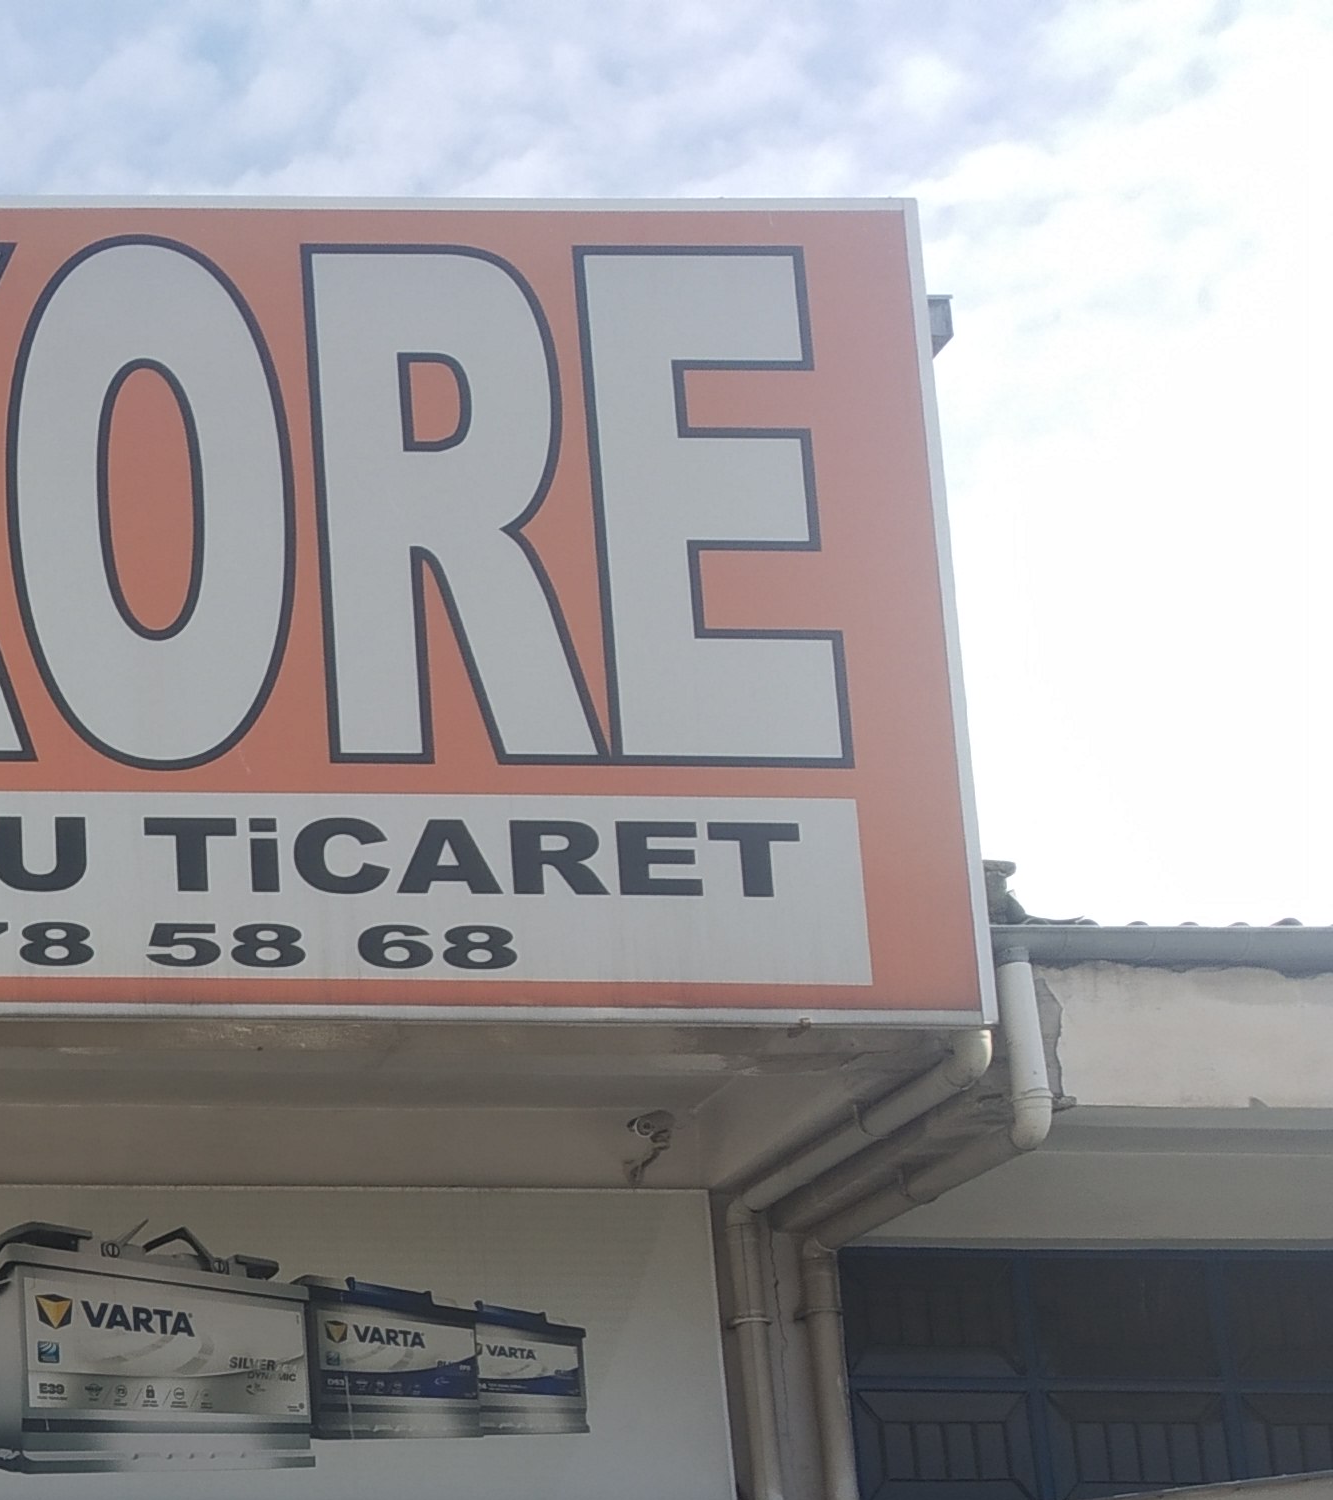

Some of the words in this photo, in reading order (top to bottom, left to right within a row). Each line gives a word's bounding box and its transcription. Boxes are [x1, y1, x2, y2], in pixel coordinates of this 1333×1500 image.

[145, 921, 303, 969] 58
[356, 922, 517, 971] 68
[80, 1300, 195, 1337] VARTA
[353, 1324, 426, 1349] VARTA
[229, 1356, 276, 1371] SILVER
[486, 1344, 537, 1360] VARTA
